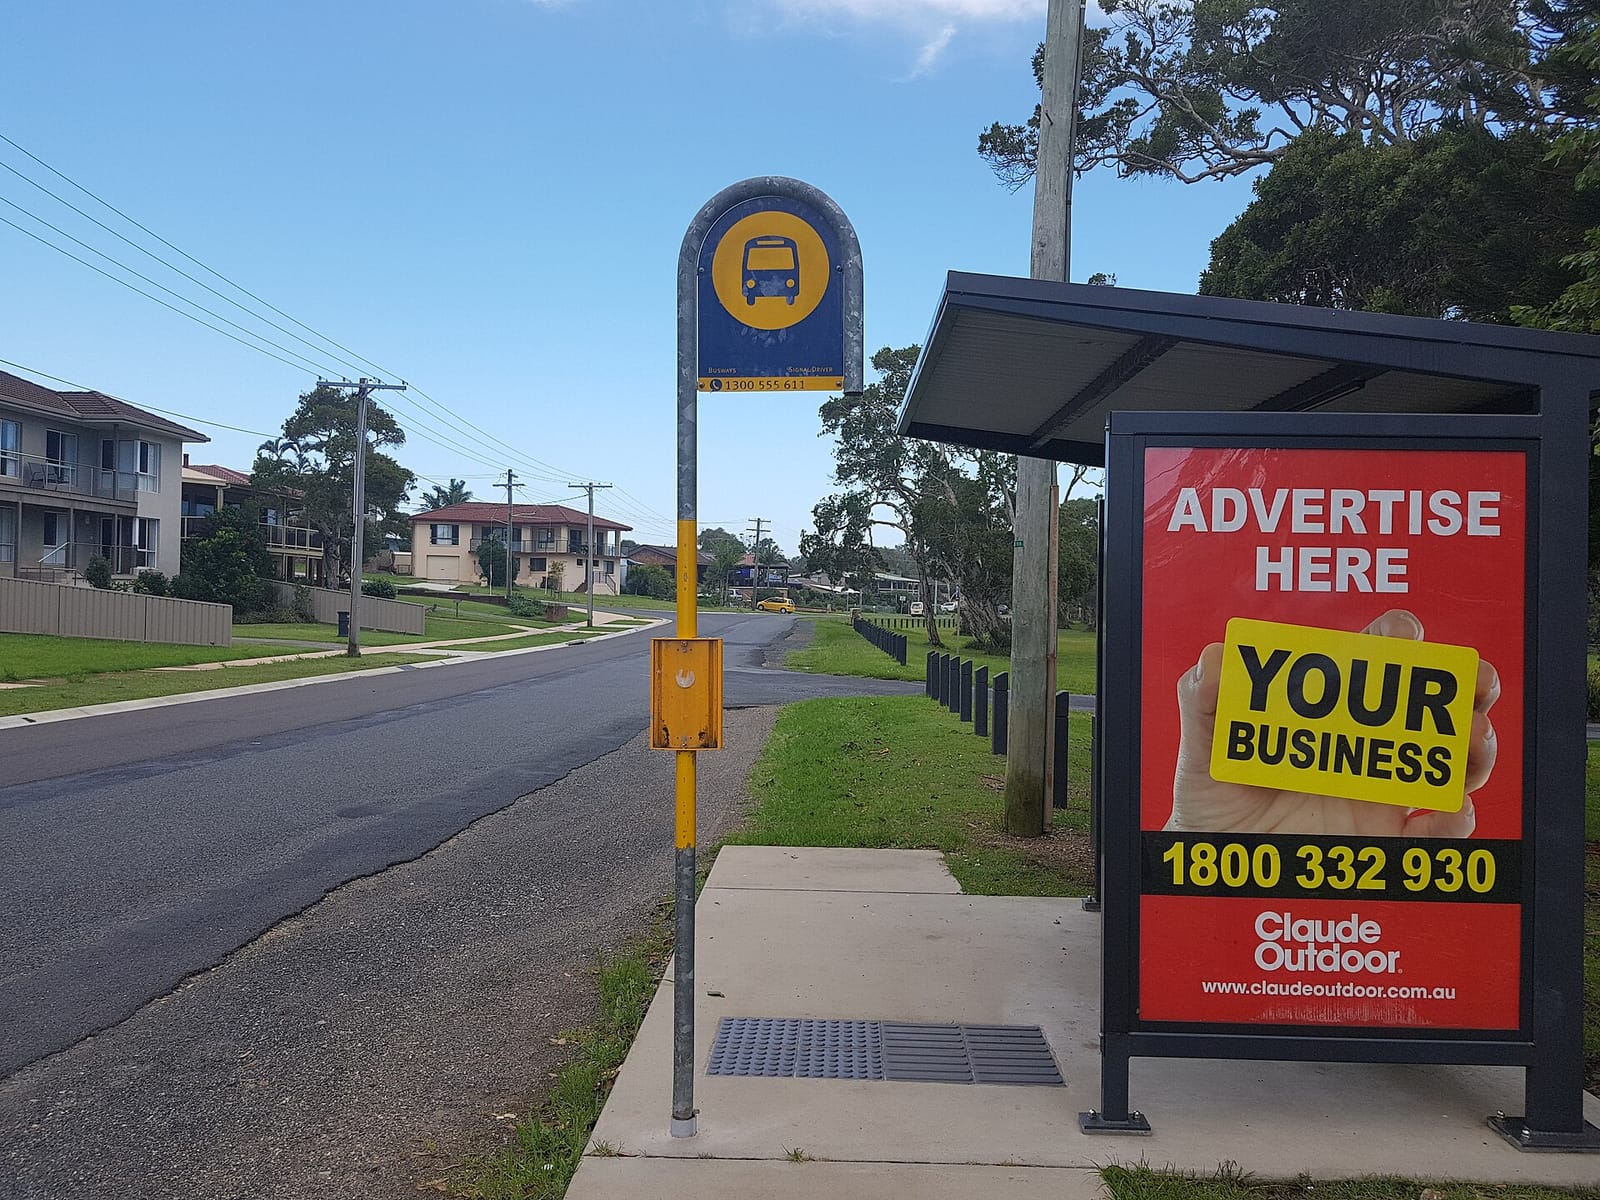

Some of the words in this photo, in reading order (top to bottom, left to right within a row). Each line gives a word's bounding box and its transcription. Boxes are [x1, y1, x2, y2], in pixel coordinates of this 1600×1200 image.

[726, 380, 754, 390] 1300
[759, 380, 779, 390] 555
[784, 380, 804, 390] 611
[1166, 487, 1501, 536] ADVERTISE
[1255, 546, 1409, 593] HERE
[1237, 645, 1458, 737] YOUR
[1226, 721, 1452, 787] BUSINESS
[1163, 842, 1281, 888] 1800
[1295, 845, 1387, 890] 332
[1402, 848, 1496, 893] 930
[1254, 911, 1381, 943] Claude
[1254, 942, 1401, 974] Outdoor
[1201, 980, 1456, 1000] www.claudeoutdoor.com.au
